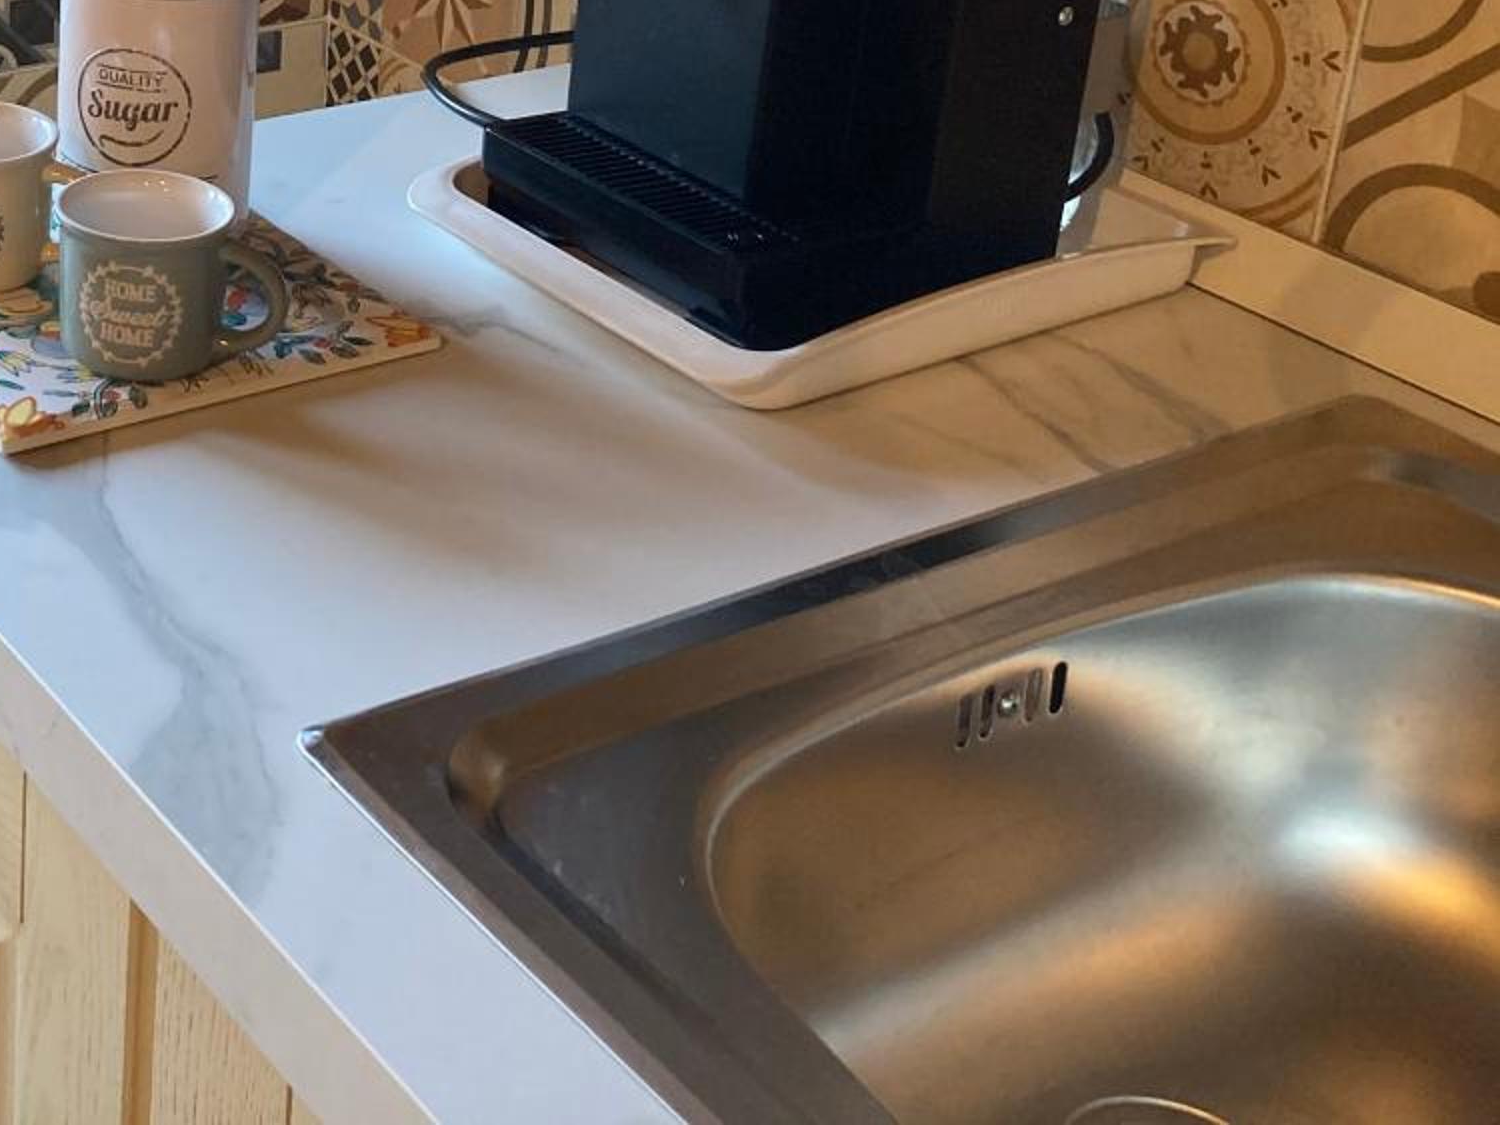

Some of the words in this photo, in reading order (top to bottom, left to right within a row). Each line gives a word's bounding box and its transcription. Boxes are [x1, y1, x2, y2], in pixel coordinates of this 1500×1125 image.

[99, 67, 166, 88] QUALITY
[87, 88, 179, 131] Sugar
[105, 278, 157, 302] HOME
[89, 297, 167, 327] Sweet
[100, 321, 155, 347] HOME
